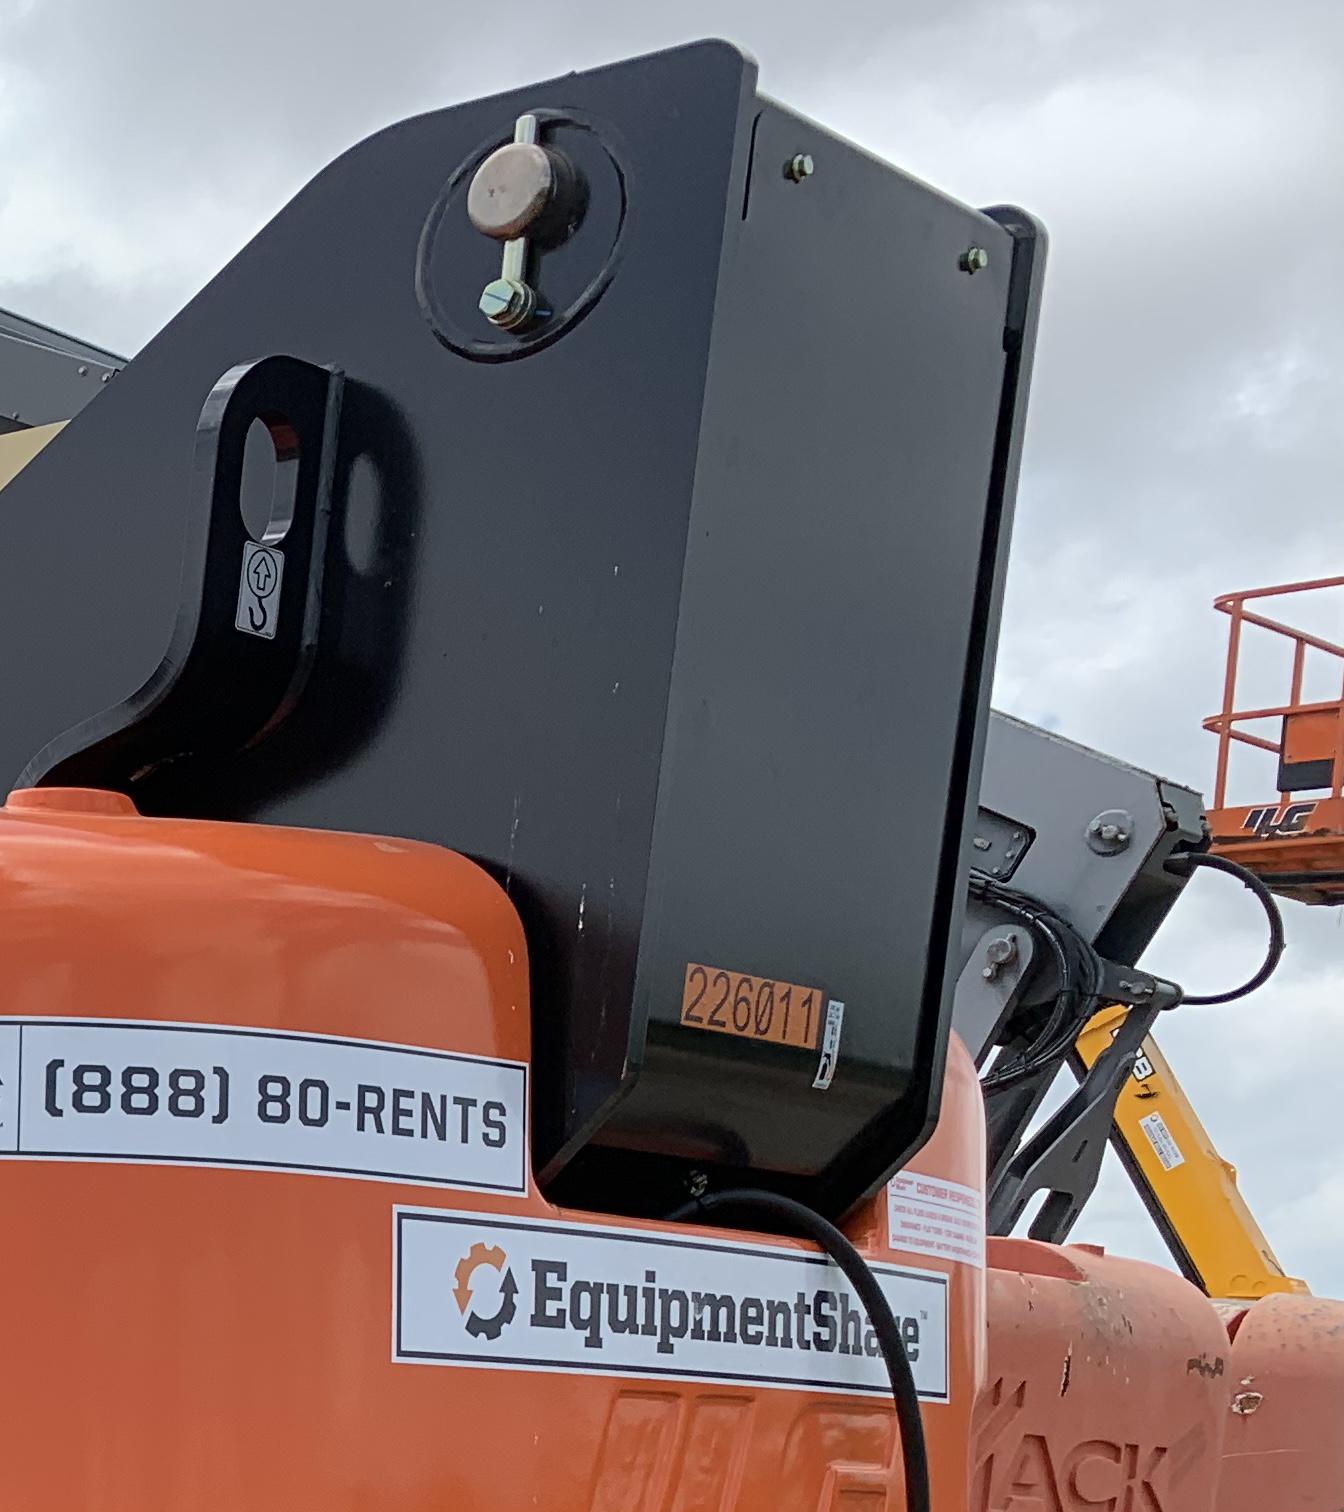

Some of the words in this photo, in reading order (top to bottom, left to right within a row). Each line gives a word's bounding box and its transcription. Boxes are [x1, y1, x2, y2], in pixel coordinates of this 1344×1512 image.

[1243, 803, 1319, 837] JLG
[684, 966, 814, 1044] 226011
[43, 1064, 229, 1126] (888)
[256, 1074, 509, 1149] 80-RENTS
